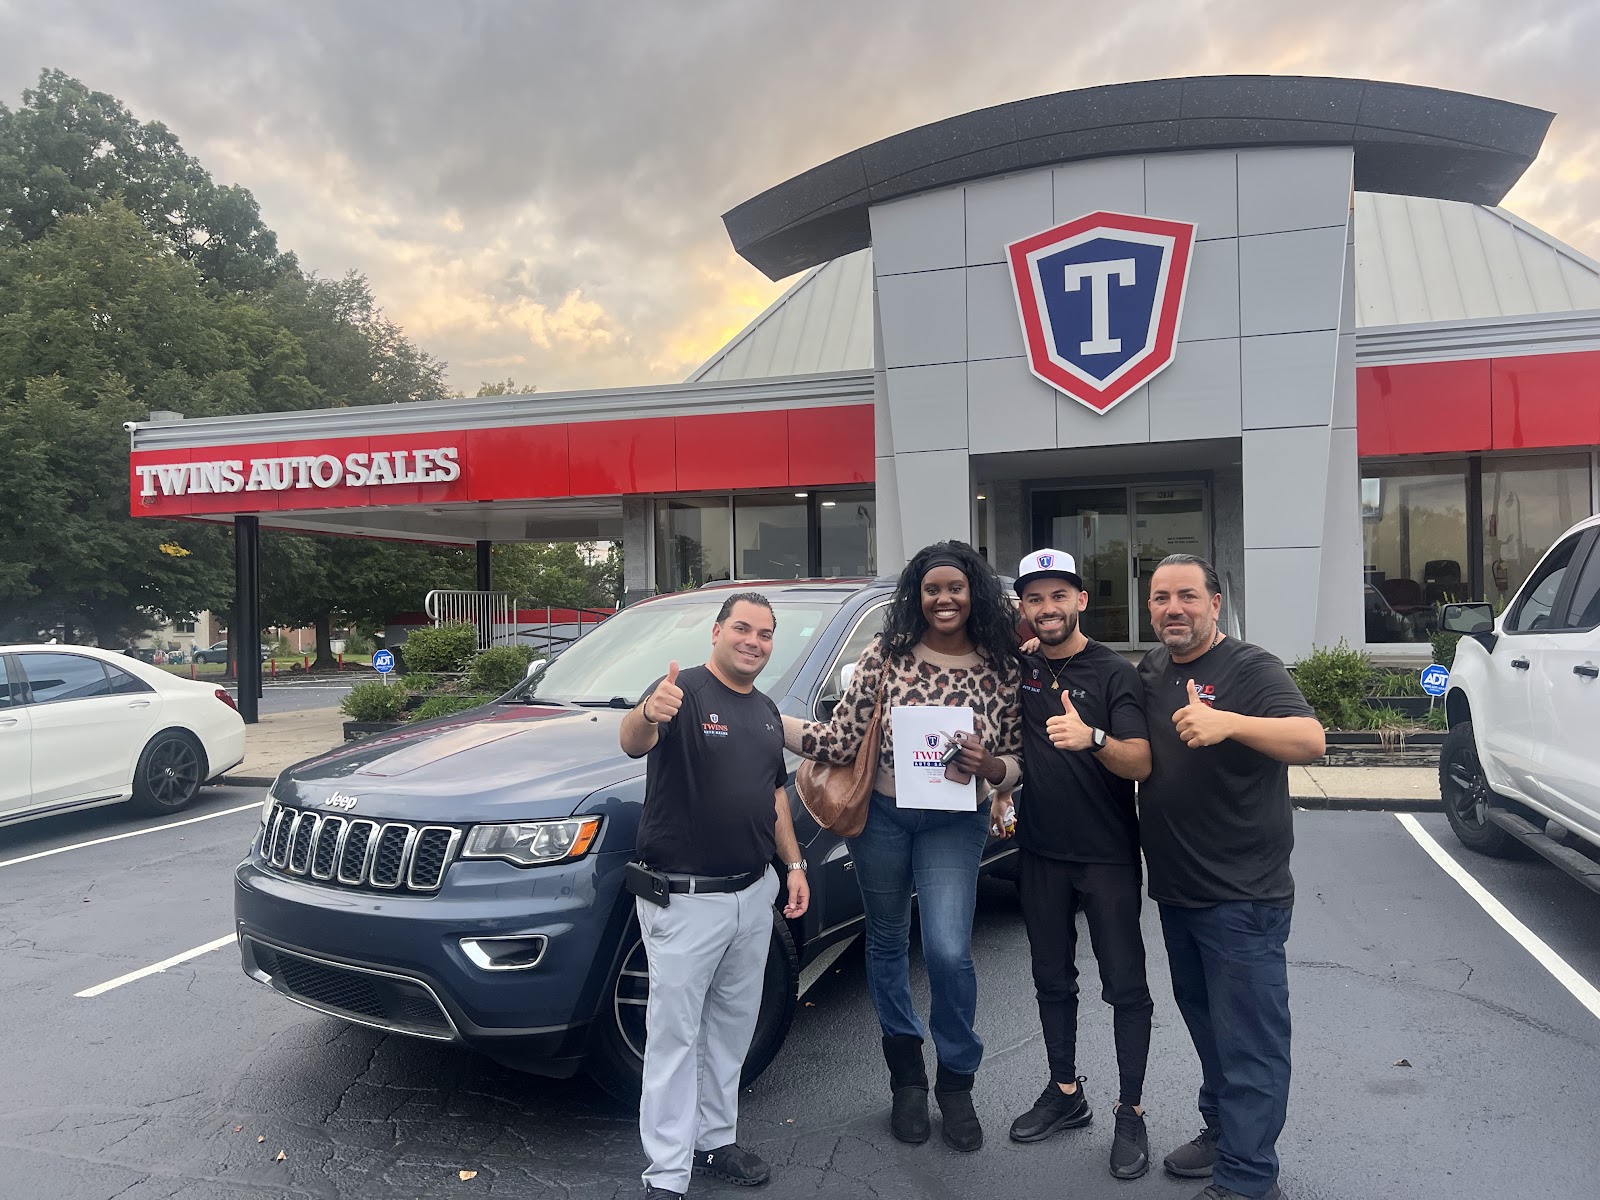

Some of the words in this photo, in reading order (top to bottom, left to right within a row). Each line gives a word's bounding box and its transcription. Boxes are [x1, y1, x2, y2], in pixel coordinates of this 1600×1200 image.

[1064, 258, 1136, 355] T
[136, 460, 244, 496] TWINS
[245, 454, 343, 491] AUTO
[345, 447, 460, 487] SALES
[376, 655, 391, 666] ADT
[1423, 672, 1449, 687] ADT
[702, 723, 728, 731] TWINS
[913, 751, 944, 760] TWI
[325, 791, 358, 812] Jeep
